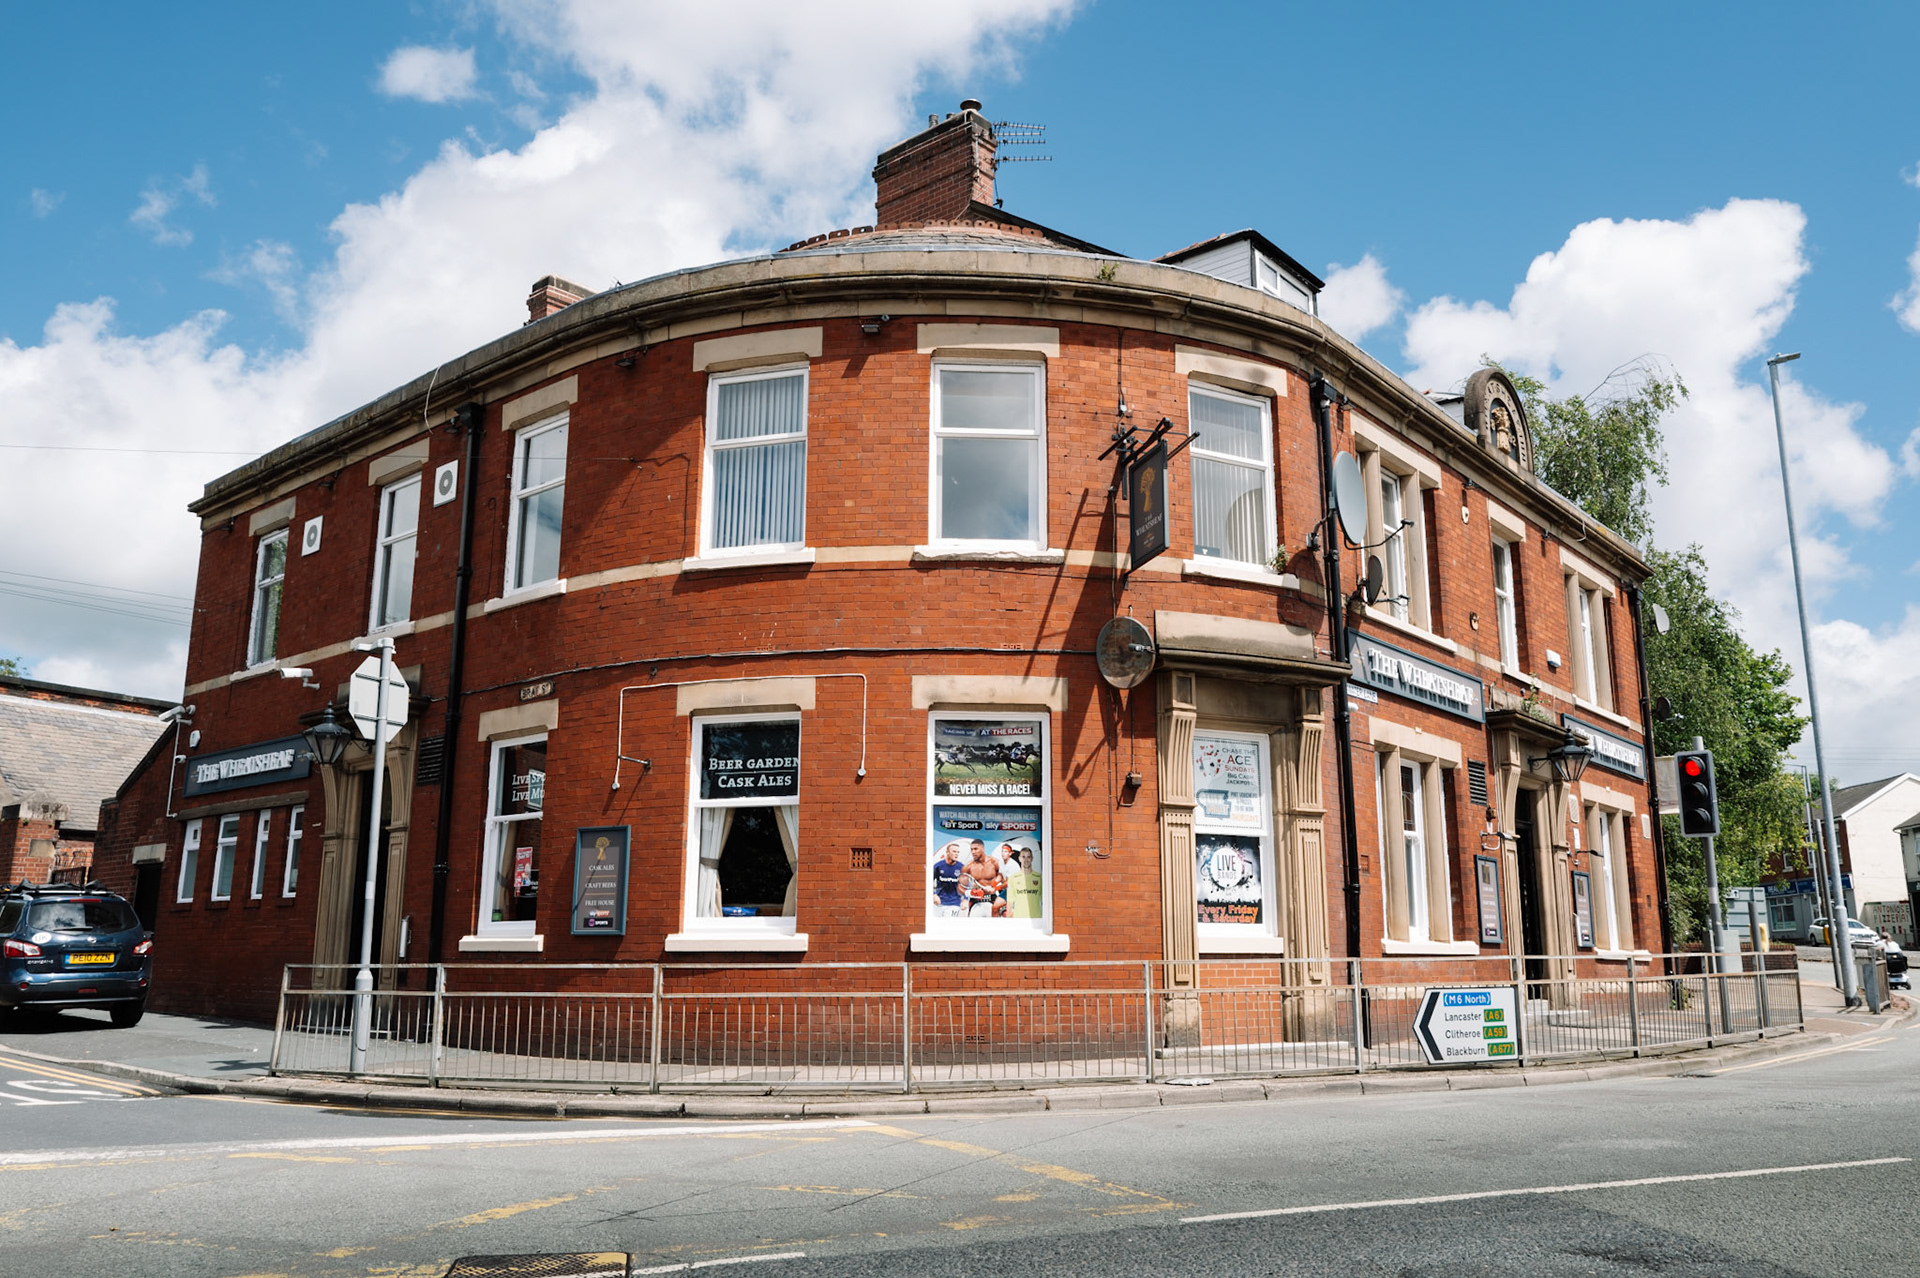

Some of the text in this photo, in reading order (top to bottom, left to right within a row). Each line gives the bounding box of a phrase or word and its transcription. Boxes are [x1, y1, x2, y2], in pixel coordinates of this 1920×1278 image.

[1368, 648, 1474, 706] THE WHEATSHEAF
[708, 756, 800, 771] BEER GARDEN
[1227, 754, 1252, 766] ACE
[196, 748, 296, 784] THE WHEATSHEAF
[1224, 765, 1255, 773] SUNDAYS
[511, 773, 530, 786] LIVE
[717, 774, 792, 788] CASK ALES
[949, 784, 1030, 795] NEVER MISS A RACE!
[511, 790, 530, 802] LIVE
[939, 811, 957, 819] WATCH
[957, 811, 967, 819] ALL
[978, 812, 1003, 820] SPORTING
[957, 821, 979, 829] Sport
[985, 821, 1036, 830] sky SPORTS
[1216, 854, 1236, 871] LIVE
[1016, 888, 1039, 896] betway
[1198, 904, 1259, 918] Every Friday
[1212, 914, 1257, 924] Saturday
[94, 952, 112, 962] ZZN
[1444, 1012, 1482, 1022] Lancaster
[1445, 1029, 1481, 1039] Clitheroe
[1446, 1046, 1486, 1056] Blackburn
